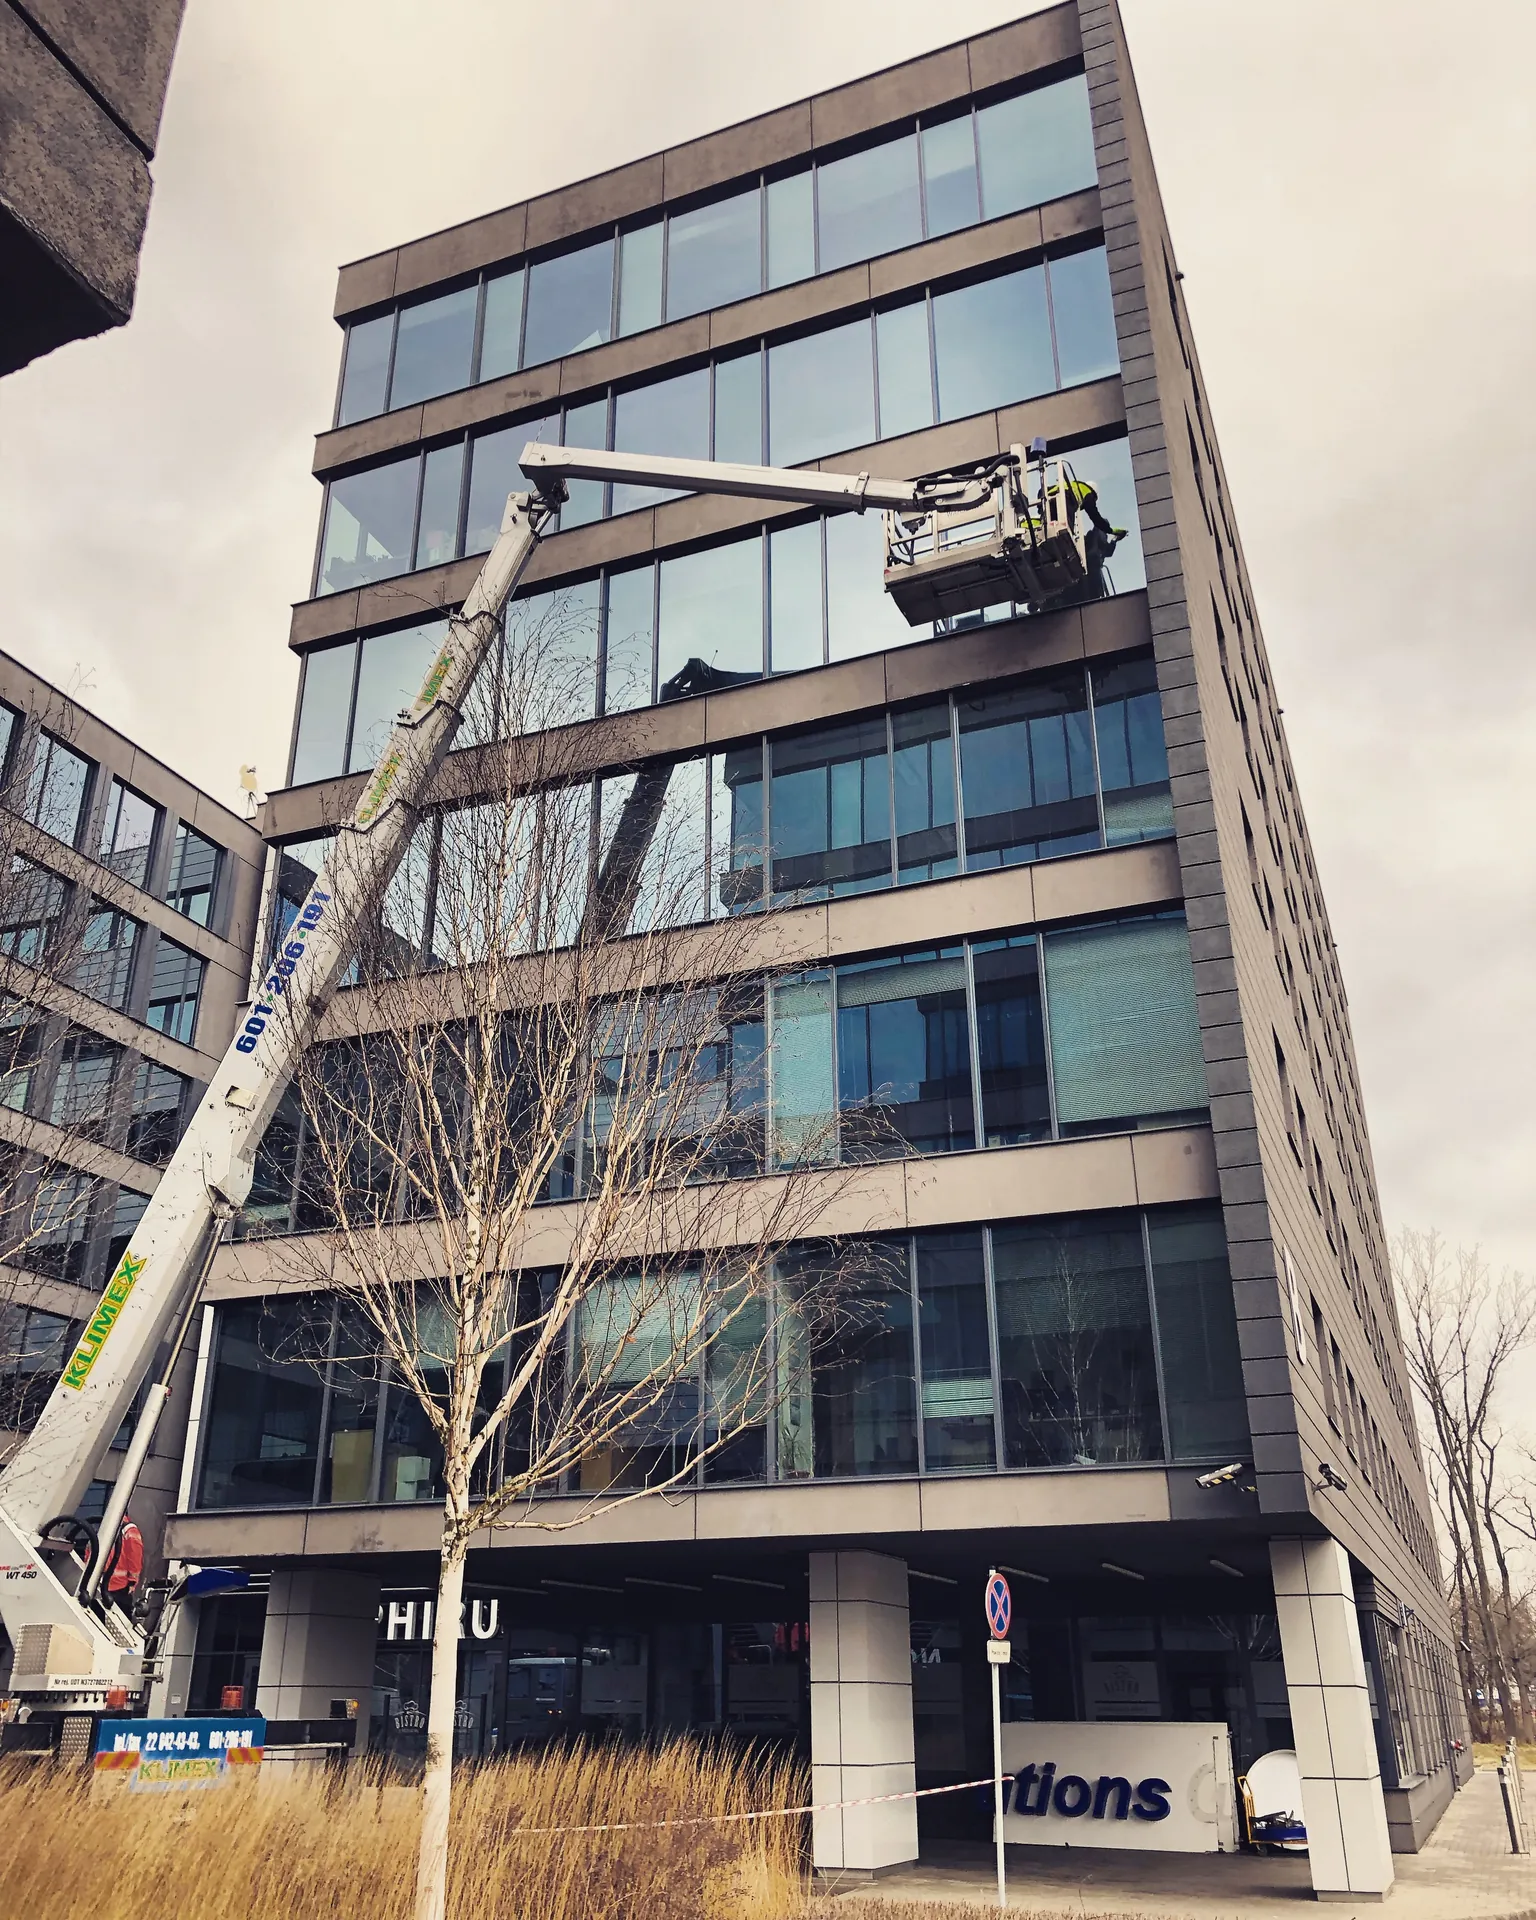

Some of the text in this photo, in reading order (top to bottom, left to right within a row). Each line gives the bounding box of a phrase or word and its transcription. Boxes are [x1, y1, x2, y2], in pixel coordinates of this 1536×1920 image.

[5, 1571, 38, 1580] WT 450
[374, 1599, 499, 1641] HIU
[394, 1714, 426, 1729] BISTRO
[145, 1731, 158, 1751] 22
[139, 1758, 219, 1781] KLIMEX
